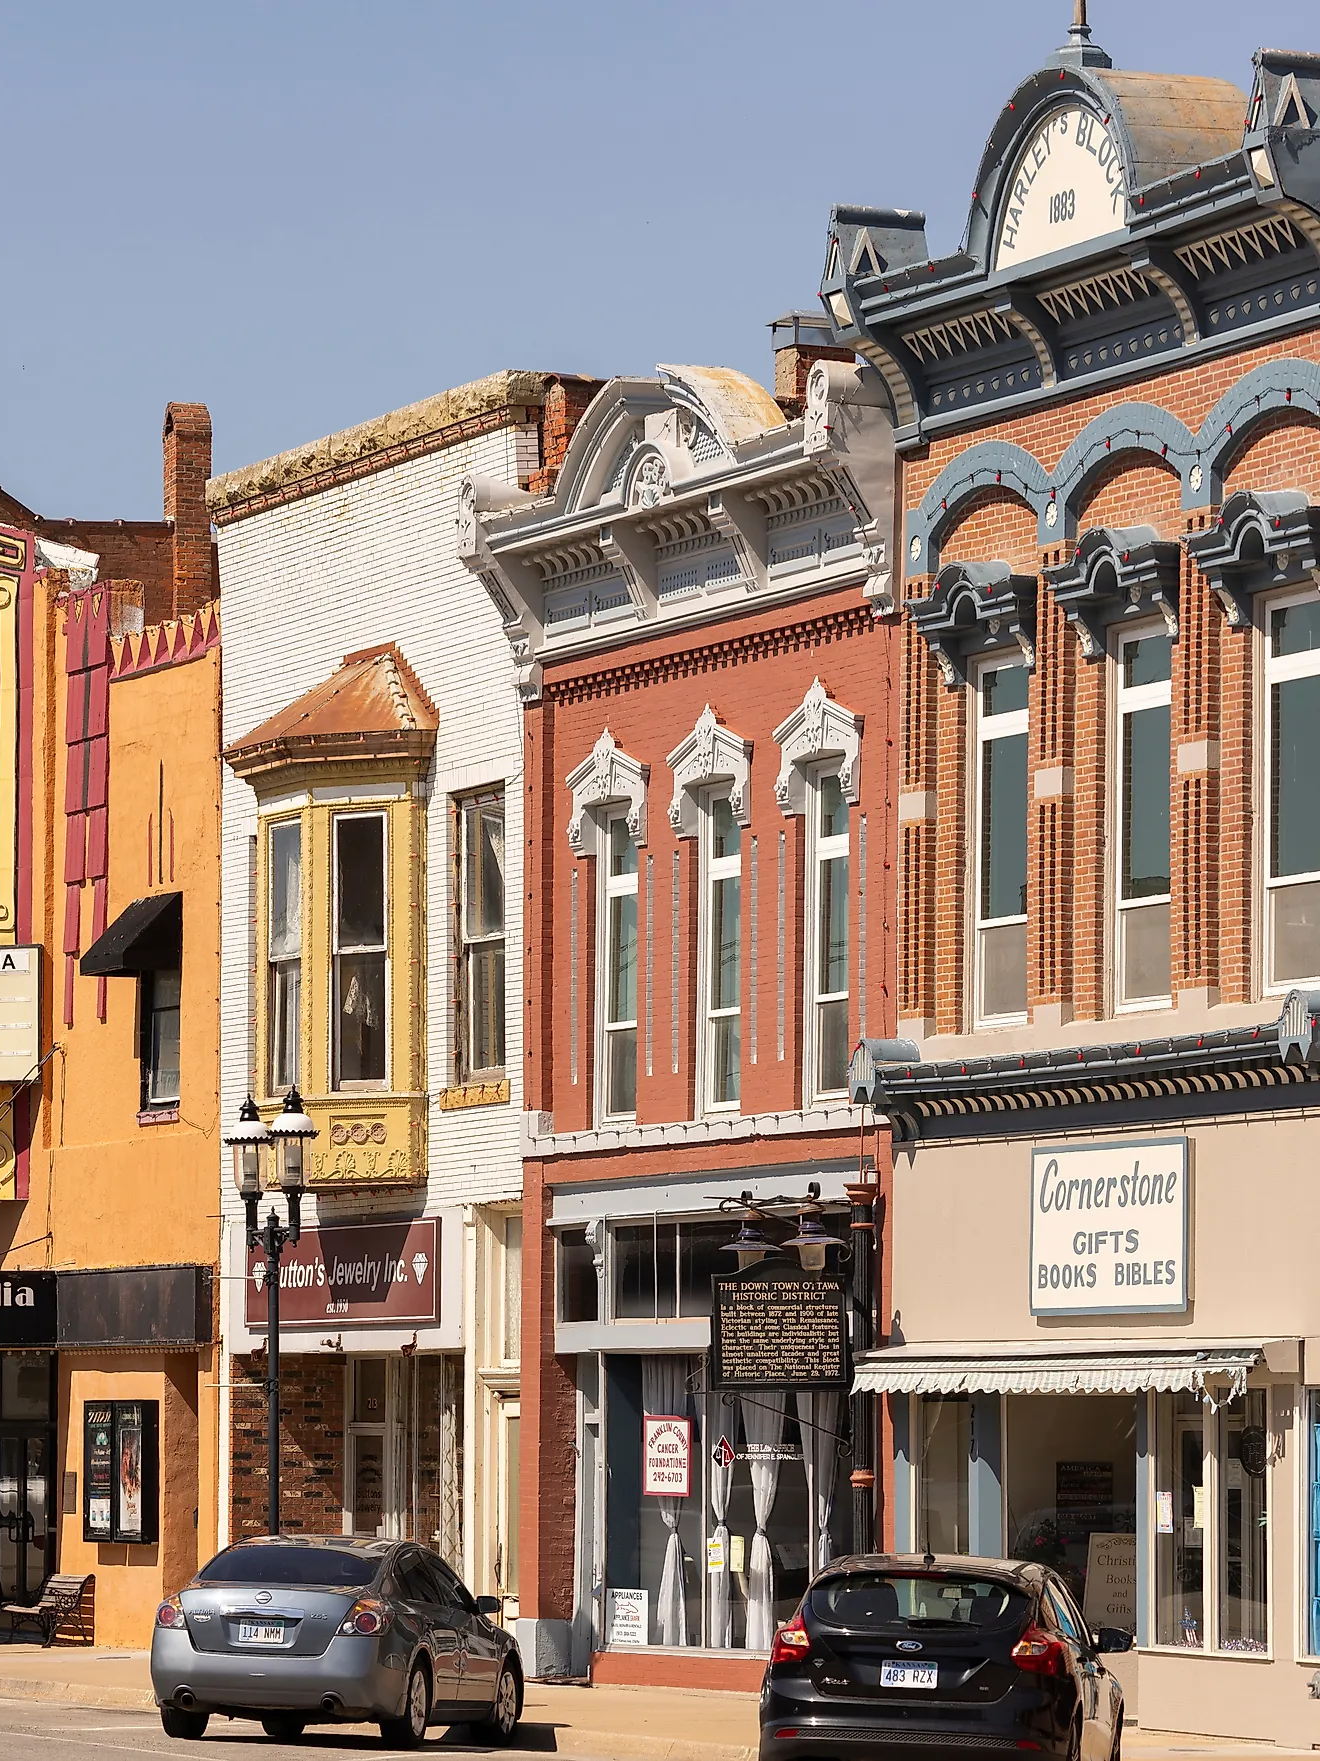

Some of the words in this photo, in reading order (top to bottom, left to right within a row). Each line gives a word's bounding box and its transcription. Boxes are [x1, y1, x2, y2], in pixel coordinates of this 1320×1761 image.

[1003, 112, 1068, 249] HARLEY'S
[1075, 112, 1125, 215] BLOCK
[1049, 189, 1075, 224] 1883
[1040, 1159, 1177, 1213] Cornerstone
[1073, 1229, 1139, 1255] GIFTS
[278, 1257, 325, 1289] utton's
[328, 1253, 381, 1291] Jewelry
[384, 1253, 408, 1283] Inc.
[1038, 1263, 1097, 1289] BOOKS
[1114, 1260, 1176, 1286] BIBLES
[719, 1282, 737, 1291] THE
[741, 1282, 768, 1291] DOWN
[772, 1282, 799, 1291] TOWN
[733, 1292, 777, 1300] HISTORIC
[782, 1292, 826, 1300] DISTRICT
[648, 1423, 673, 1449] FRANKLIN
[673, 1426, 688, 1451] COUNTY
[657, 1444, 679, 1453] CANCER
[746, 1444, 759, 1452] THE
[760, 1444, 772, 1452] LAW
[653, 1472, 682, 1482] 242-6703
[1106, 1575, 1136, 1585] Books
[611, 1591, 642, 1600] APPLIANCES
[1106, 1604, 1132, 1614] Gifts
[243, 1626, 258, 1638] 114
[886, 1669, 905, 1682] 483
[913, 1670, 933, 1683] RZX
